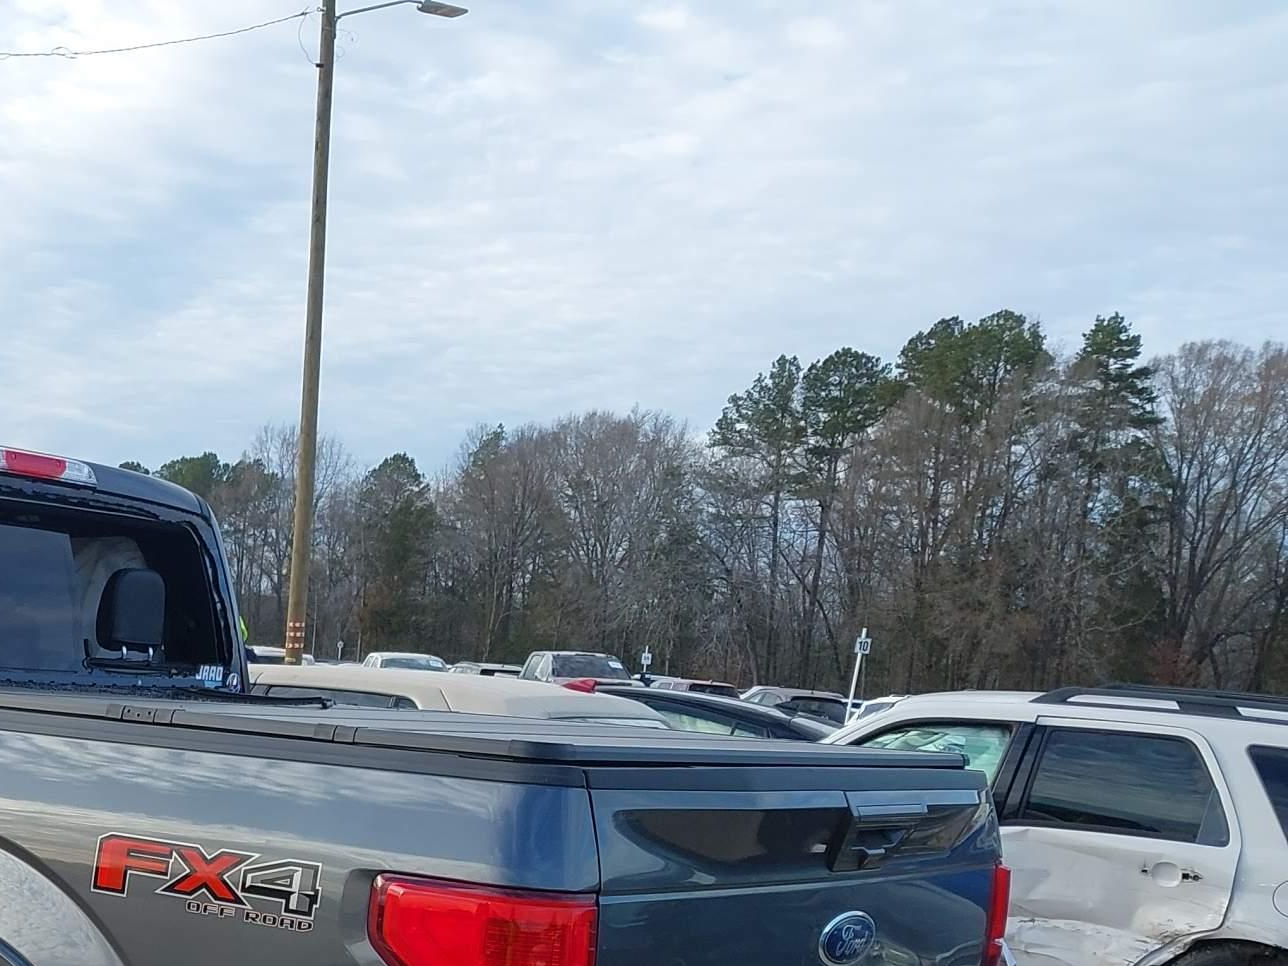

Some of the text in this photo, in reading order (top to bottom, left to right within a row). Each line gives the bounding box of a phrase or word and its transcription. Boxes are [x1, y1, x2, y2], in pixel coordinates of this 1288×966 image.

[858, 640, 869, 651] 10
[91, 832, 322, 920] FX4
[186, 899, 314, 932] OFF ROAD
[835, 924, 869, 957] Ford
